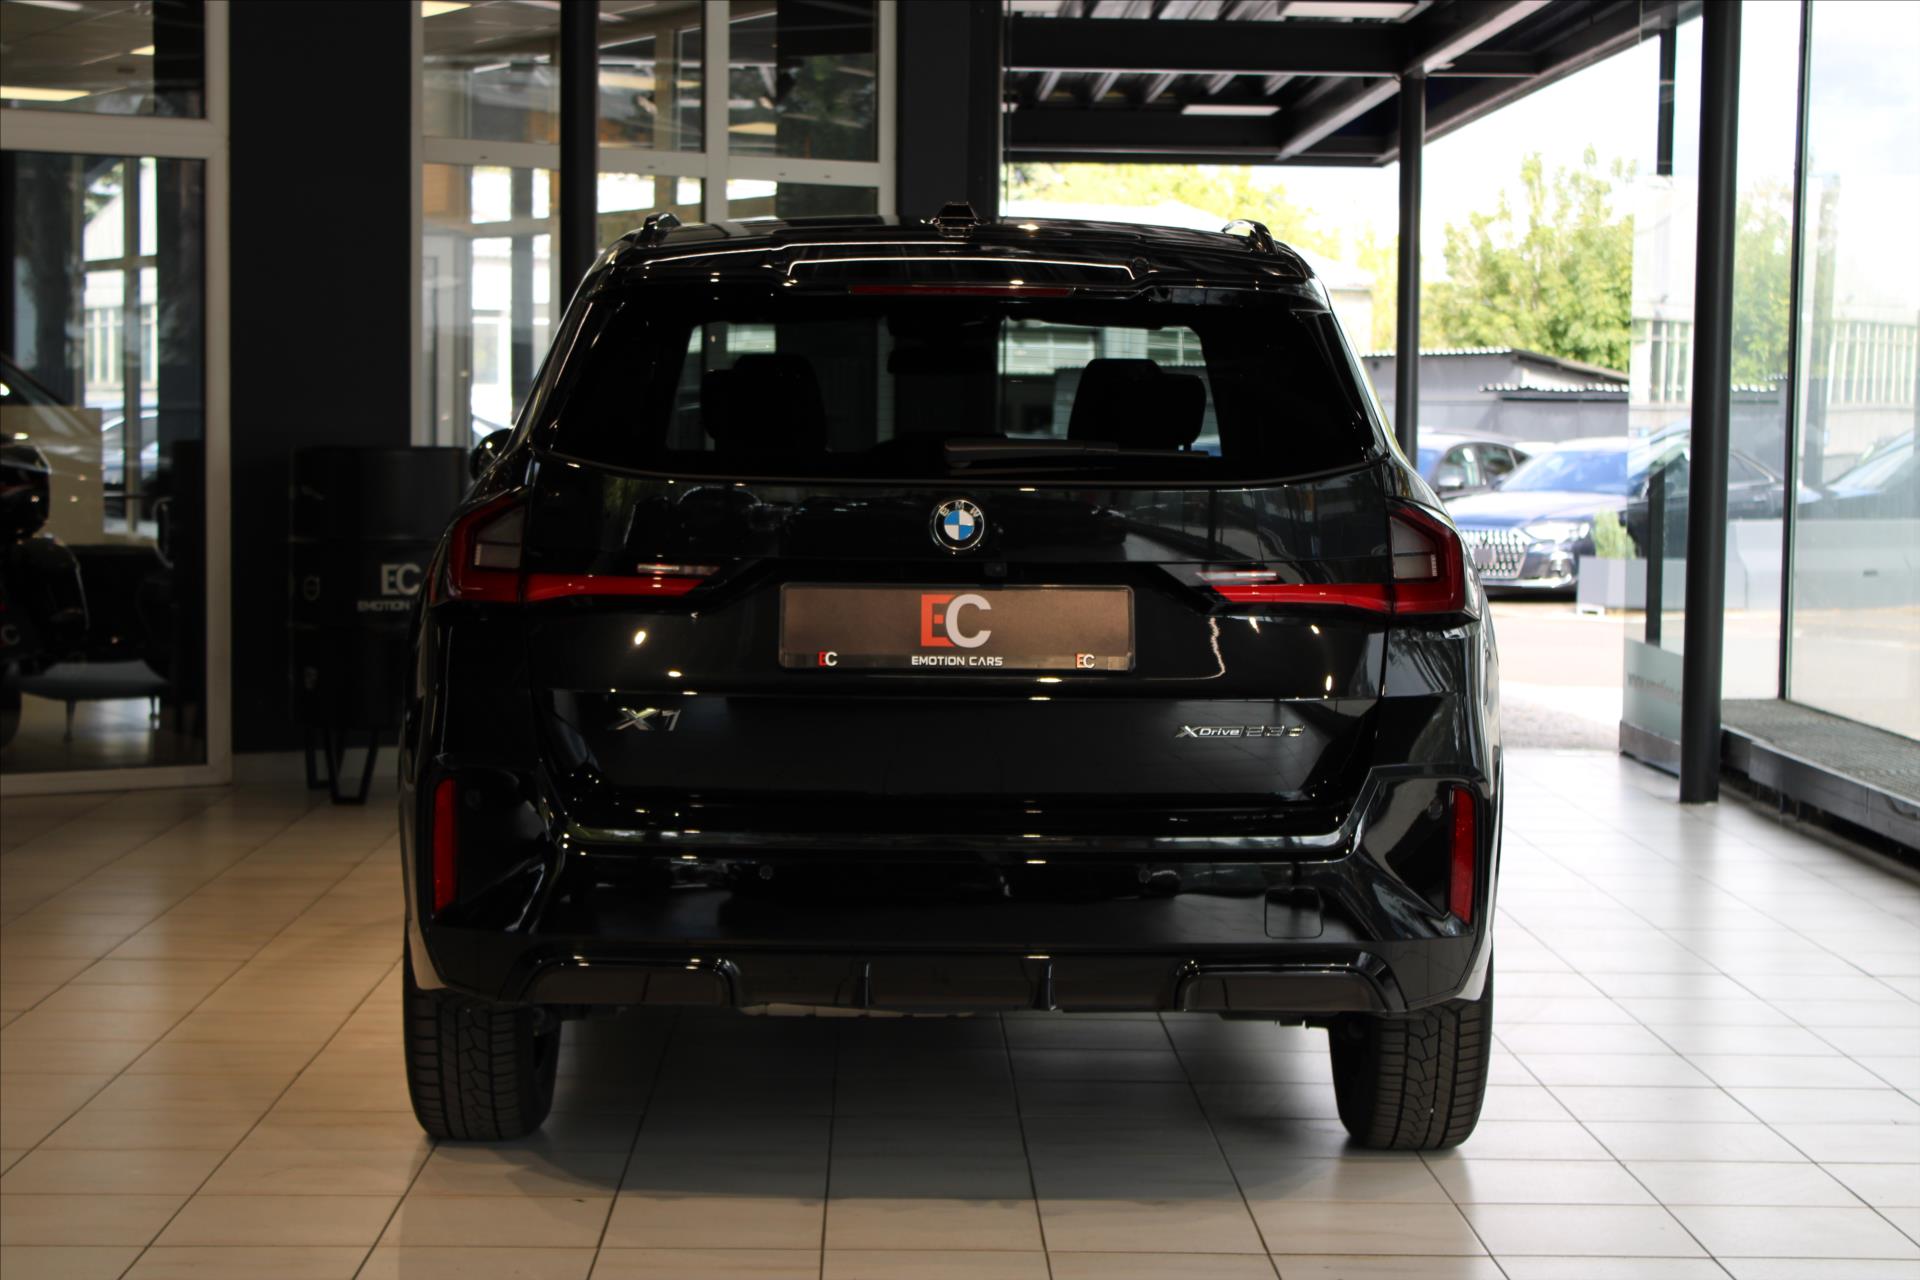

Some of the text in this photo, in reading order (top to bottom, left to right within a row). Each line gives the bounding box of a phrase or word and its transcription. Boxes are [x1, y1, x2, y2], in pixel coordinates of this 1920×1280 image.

[939, 500, 981, 518] BMW
[381, 563, 421, 596] EC
[357, 600, 411, 612] EMOTION
[921, 594, 993, 648] EC
[818, 652, 838, 667] EC
[911, 656, 1003, 667] EMOTION CARS
[1076, 653, 1096, 669] EC
[609, 707, 680, 731] X1
